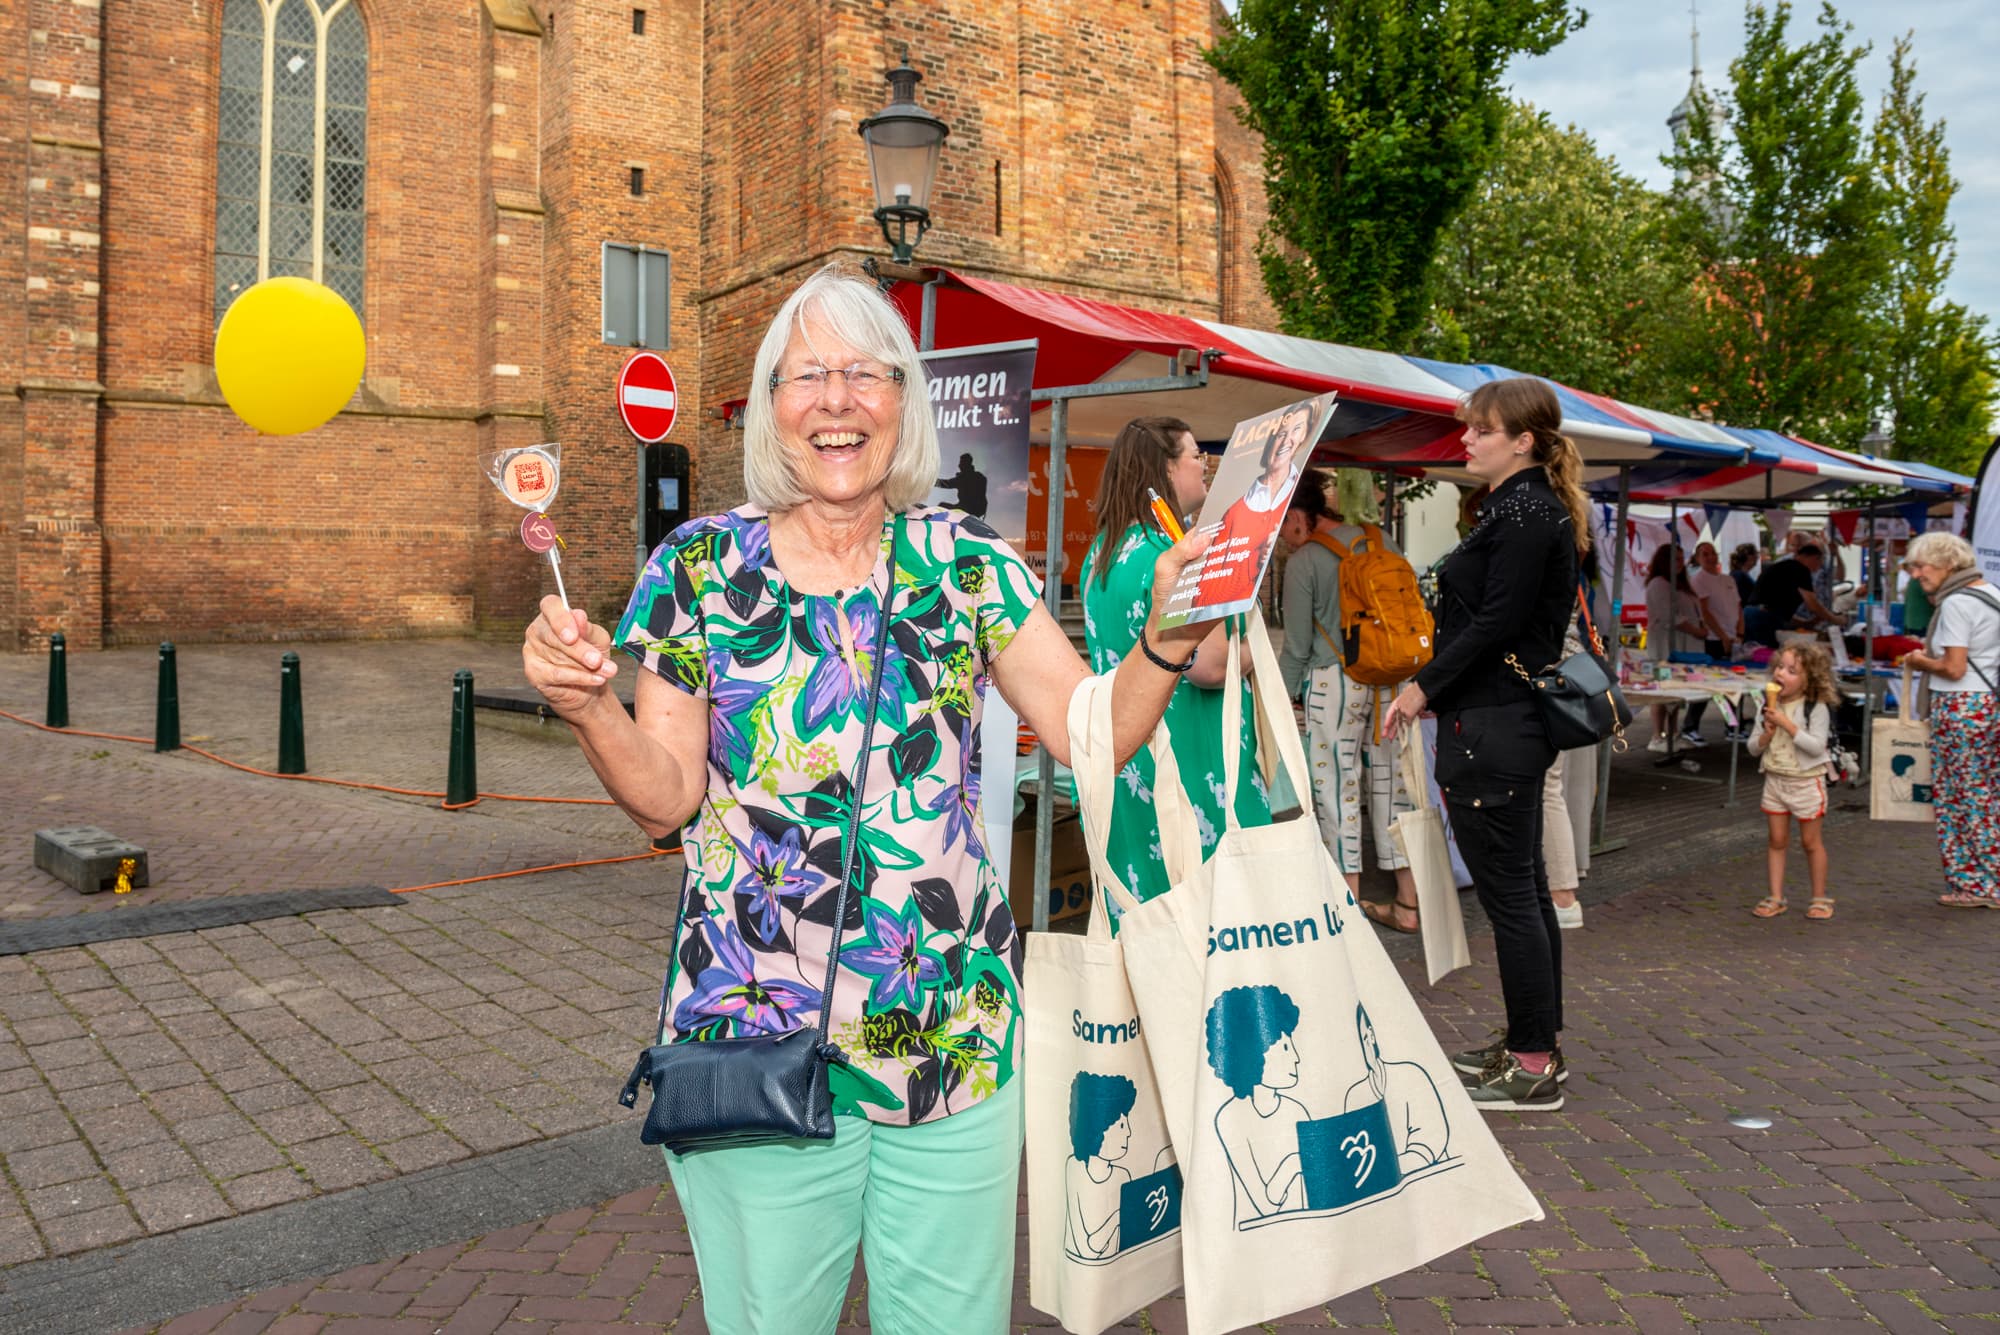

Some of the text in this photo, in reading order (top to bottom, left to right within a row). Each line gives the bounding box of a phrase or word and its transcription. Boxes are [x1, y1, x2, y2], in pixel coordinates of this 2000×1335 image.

[927, 370, 1007, 402] amen
[1229, 536, 1250, 548] Kom
[1207, 555, 1226, 567] eens
[1226, 550, 1251, 562] langs
[1202, 568, 1233, 581] nieuwe
